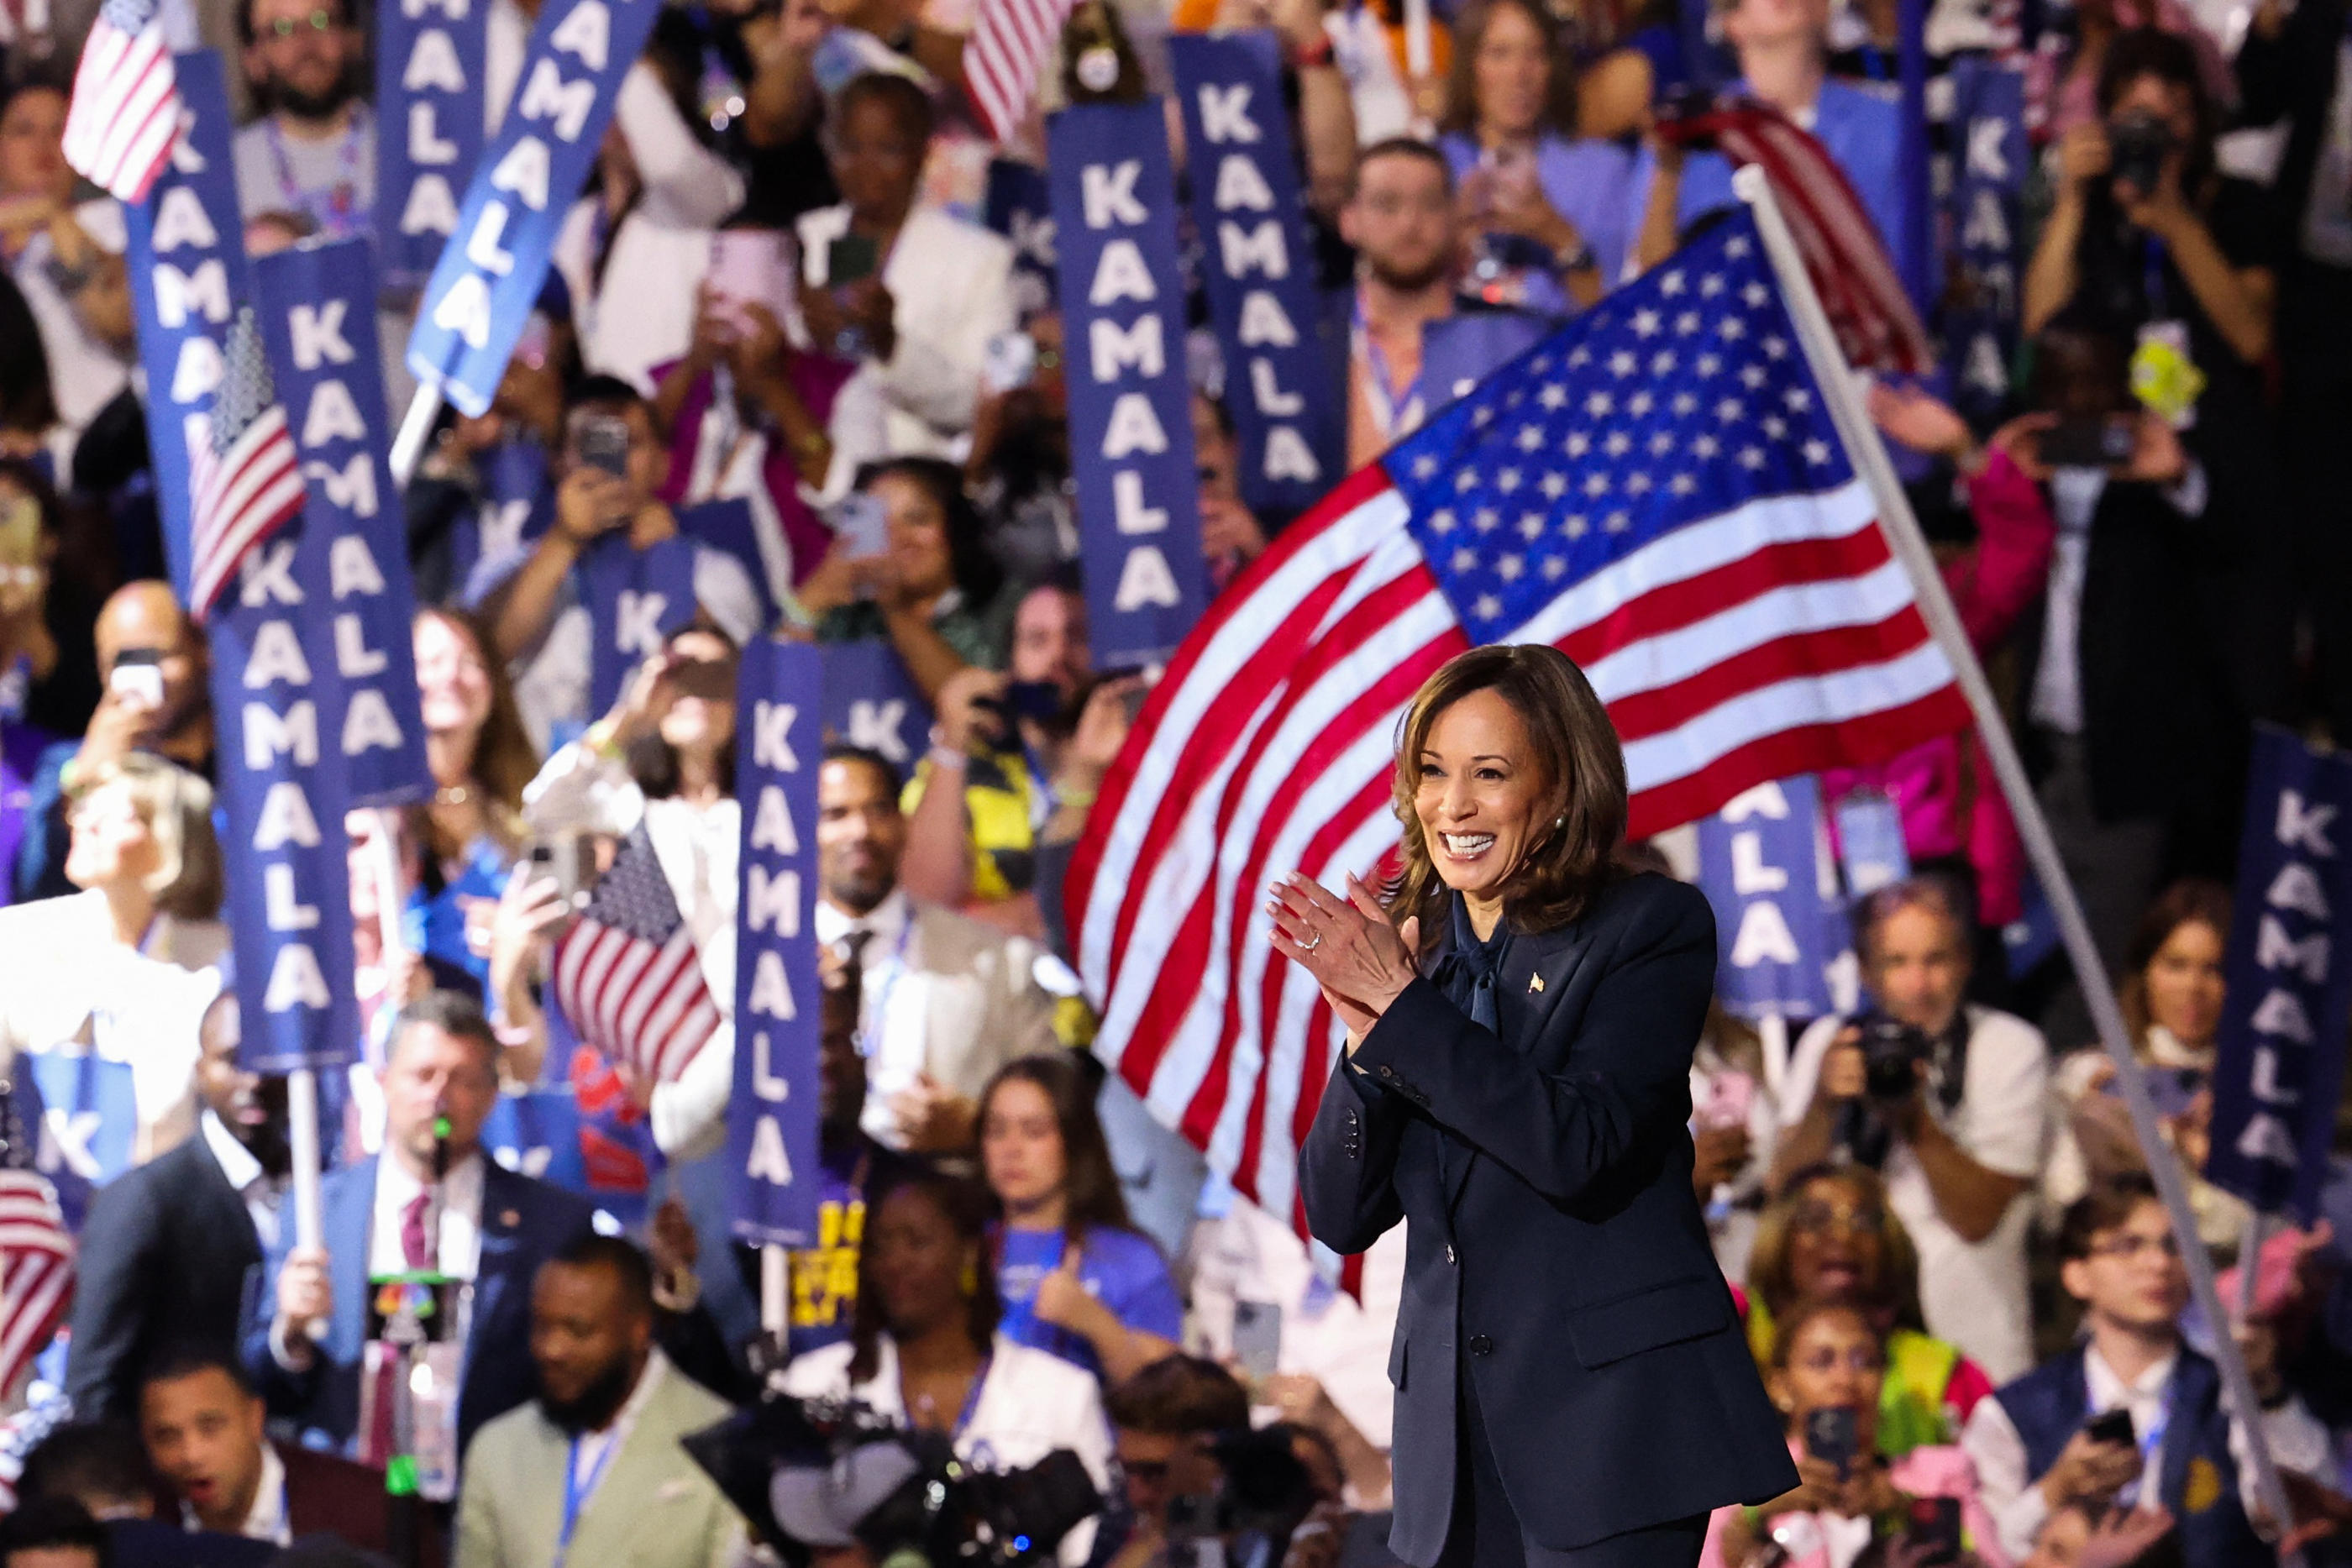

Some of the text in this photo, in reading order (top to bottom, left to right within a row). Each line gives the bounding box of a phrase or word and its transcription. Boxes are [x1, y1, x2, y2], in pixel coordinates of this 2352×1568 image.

[1082, 160, 1180, 613] KAMALA
[1197, 83, 1321, 484] KAMALA
[288, 297, 406, 754] KAMALA
[616, 589, 669, 653] K
[239, 540, 332, 1010] KAMALA
[848, 697, 911, 763] K
[36, 1107, 105, 1179] K
[747, 699, 802, 1187] KAMALA
[2236, 788, 2341, 1168] KAMALA
